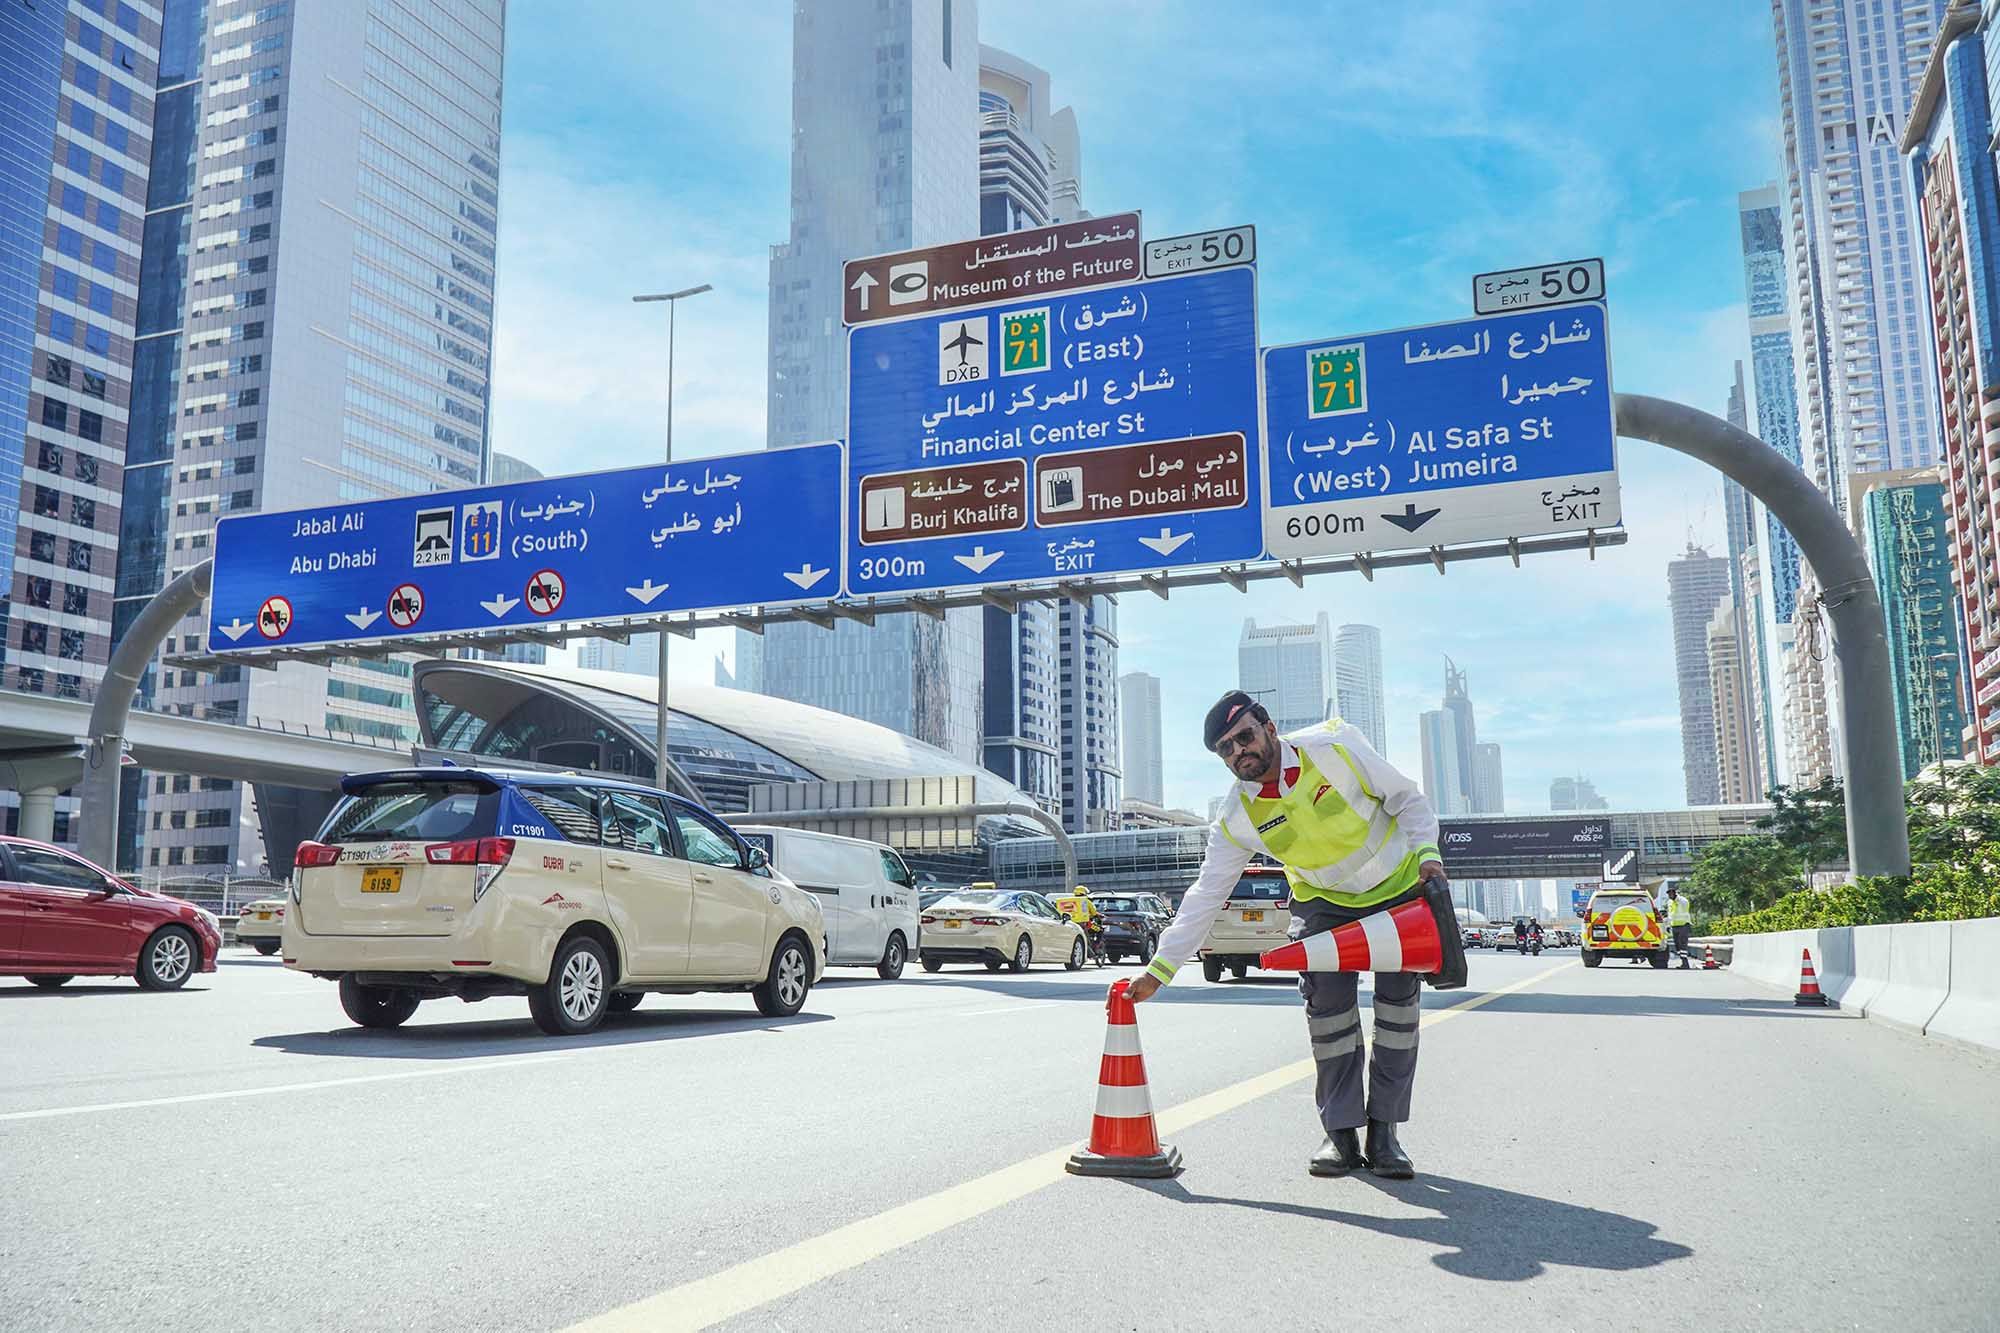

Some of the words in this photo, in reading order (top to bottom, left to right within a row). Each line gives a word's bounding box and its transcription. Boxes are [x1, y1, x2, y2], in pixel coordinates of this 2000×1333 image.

[1064, 226, 1136, 247] متحف
[1201, 232, 1244, 262] 50
[965, 233, 1058, 271] المستقبل
[1153, 240, 1192, 260] مخرج
[1167, 256, 1193, 270] EXIT
[933, 274, 1007, 301] Museum
[1012, 271, 1032, 287] of
[1036, 264, 1066, 284] the
[1072, 255, 1134, 278] Future
[1484, 276, 1530, 294] مخرج
[1541, 266, 1591, 298] 50
[1501, 292, 1530, 305] EXIT
[1011, 322, 1022, 336] D
[1508, 318, 1591, 359] شارع
[1010, 339, 1039, 365] 71
[1063, 334, 1144, 368] (East)
[1404, 328, 1490, 364] الصفا
[946, 366, 980, 383] DXB
[1320, 360, 1333, 375] D
[1005, 377, 1088, 415] المركز
[1103, 366, 1174, 405] شارع
[1319, 379, 1355, 407] 71
[1501, 374, 1592, 405] جميرا
[921, 394, 995, 435] المالي
[921, 427, 1022, 458] Financial
[1030, 418, 1110, 446] Center
[1118, 412, 1144, 434] St
[1407, 431, 1436, 454] Al
[1445, 424, 1510, 450] Safa
[1520, 416, 1553, 440] St
[1138, 454, 1184, 478] مول
[1195, 449, 1238, 480] دبي
[1408, 452, 1518, 484] Jumeira
[642, 472, 688, 509] علي
[693, 467, 742, 496] جبل
[911, 475, 972, 499] خليفة
[983, 475, 1021, 498] برج
[1293, 464, 1391, 501] (West)
[1541, 482, 1601, 505] مخرج
[1087, 493, 1123, 512] The
[1129, 482, 1187, 506] Dubai
[1194, 478, 1239, 501] Mall
[293, 515, 337, 537] Jabal
[341, 512, 364, 531] Ali
[712, 502, 742, 534] أبو
[911, 512, 947, 531] Burj
[953, 503, 1018, 526] Khalifa
[1552, 502, 1601, 522] EXIT
[651, 512, 701, 549] ظبي
[1286, 514, 1364, 538] 600m
[471, 532, 491, 554] 11
[511, 528, 588, 558] (South)
[1047, 536, 1095, 556] مخرج
[290, 556, 323, 574] Abu
[328, 548, 376, 570] Dhabi
[416, 554, 431, 564] 2.2
[433, 551, 450, 562] km
[859, 558, 925, 580] 300m
[1055, 554, 1097, 572] EXIT
[512, 824, 545, 836] CT1901
[340, 850, 370, 862] CT1901
[543, 856, 564, 870] DUBAI
[371, 878, 391, 890] 6159
